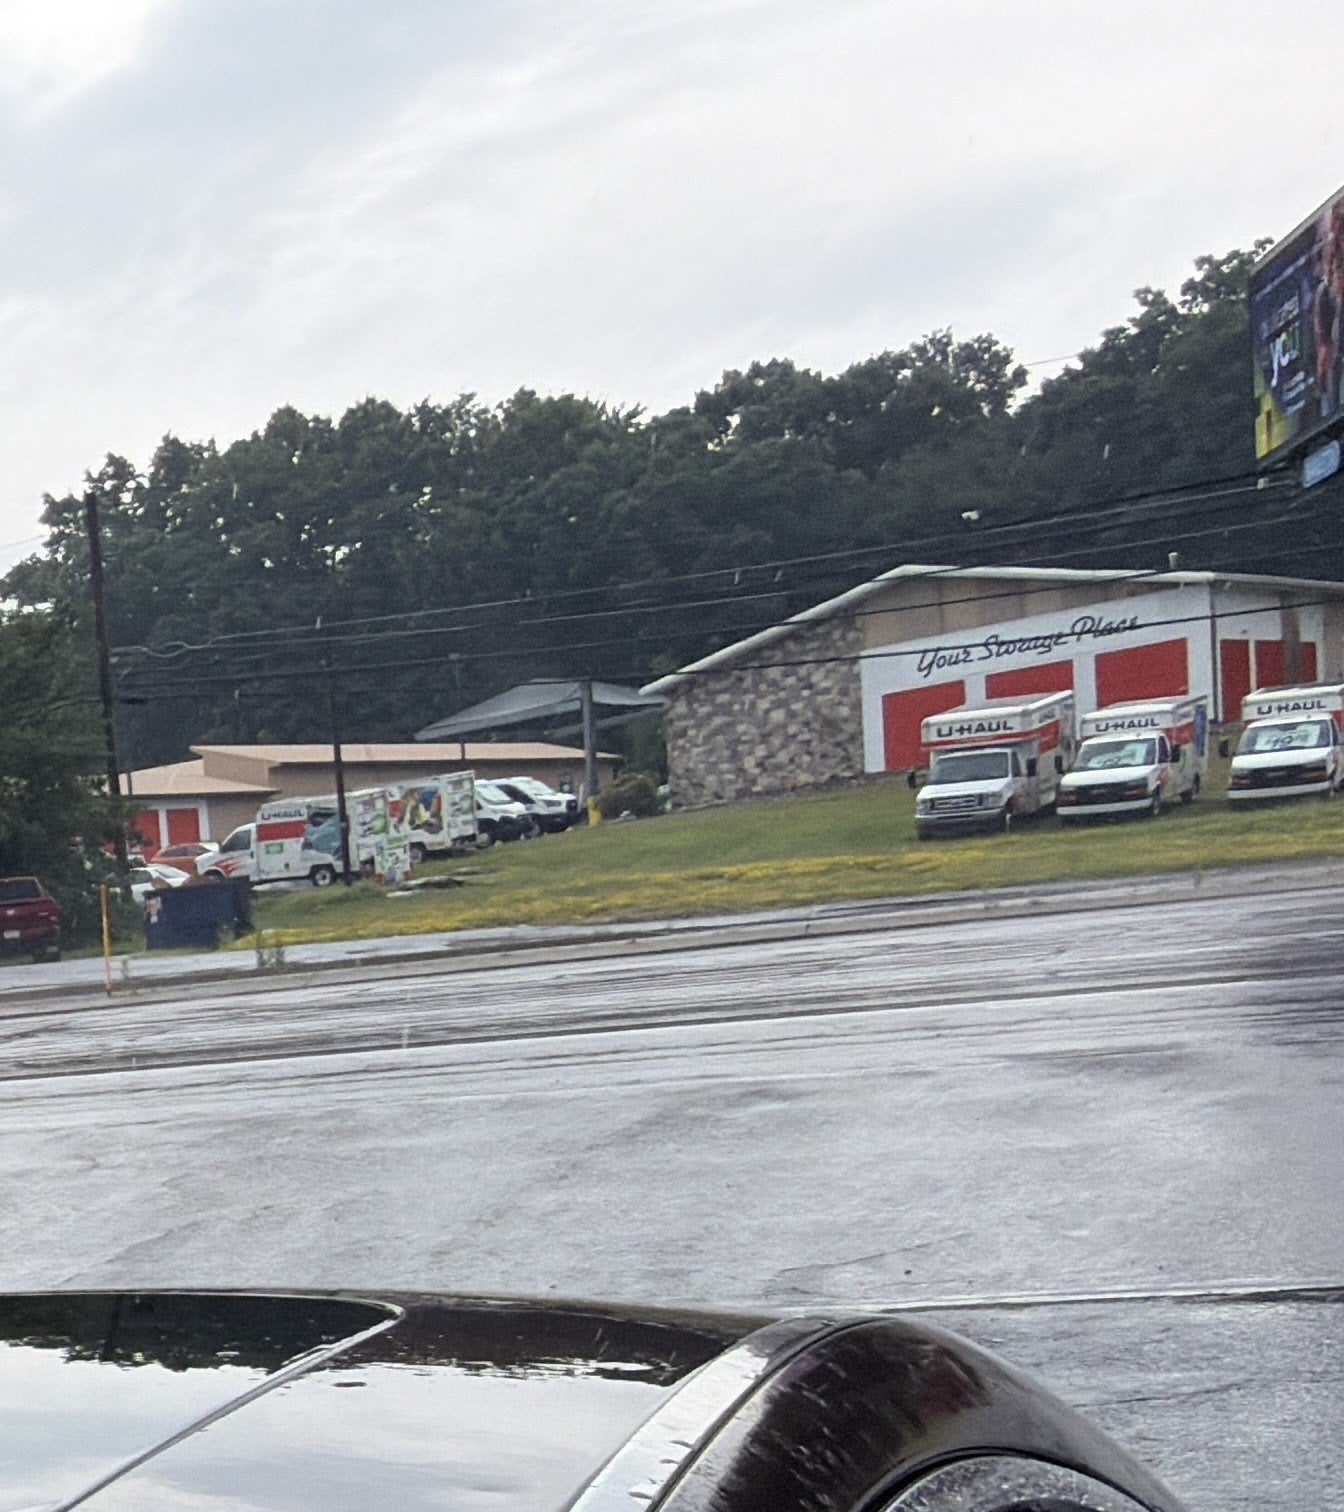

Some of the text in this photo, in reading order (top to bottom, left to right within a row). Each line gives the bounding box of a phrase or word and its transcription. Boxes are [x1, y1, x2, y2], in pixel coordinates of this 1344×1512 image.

[916, 649, 975, 678] Your
[1070, 615, 1139, 642] Place
[936, 720, 1014, 738] U-HAUL
[1095, 717, 1160, 732] U-HAUL
